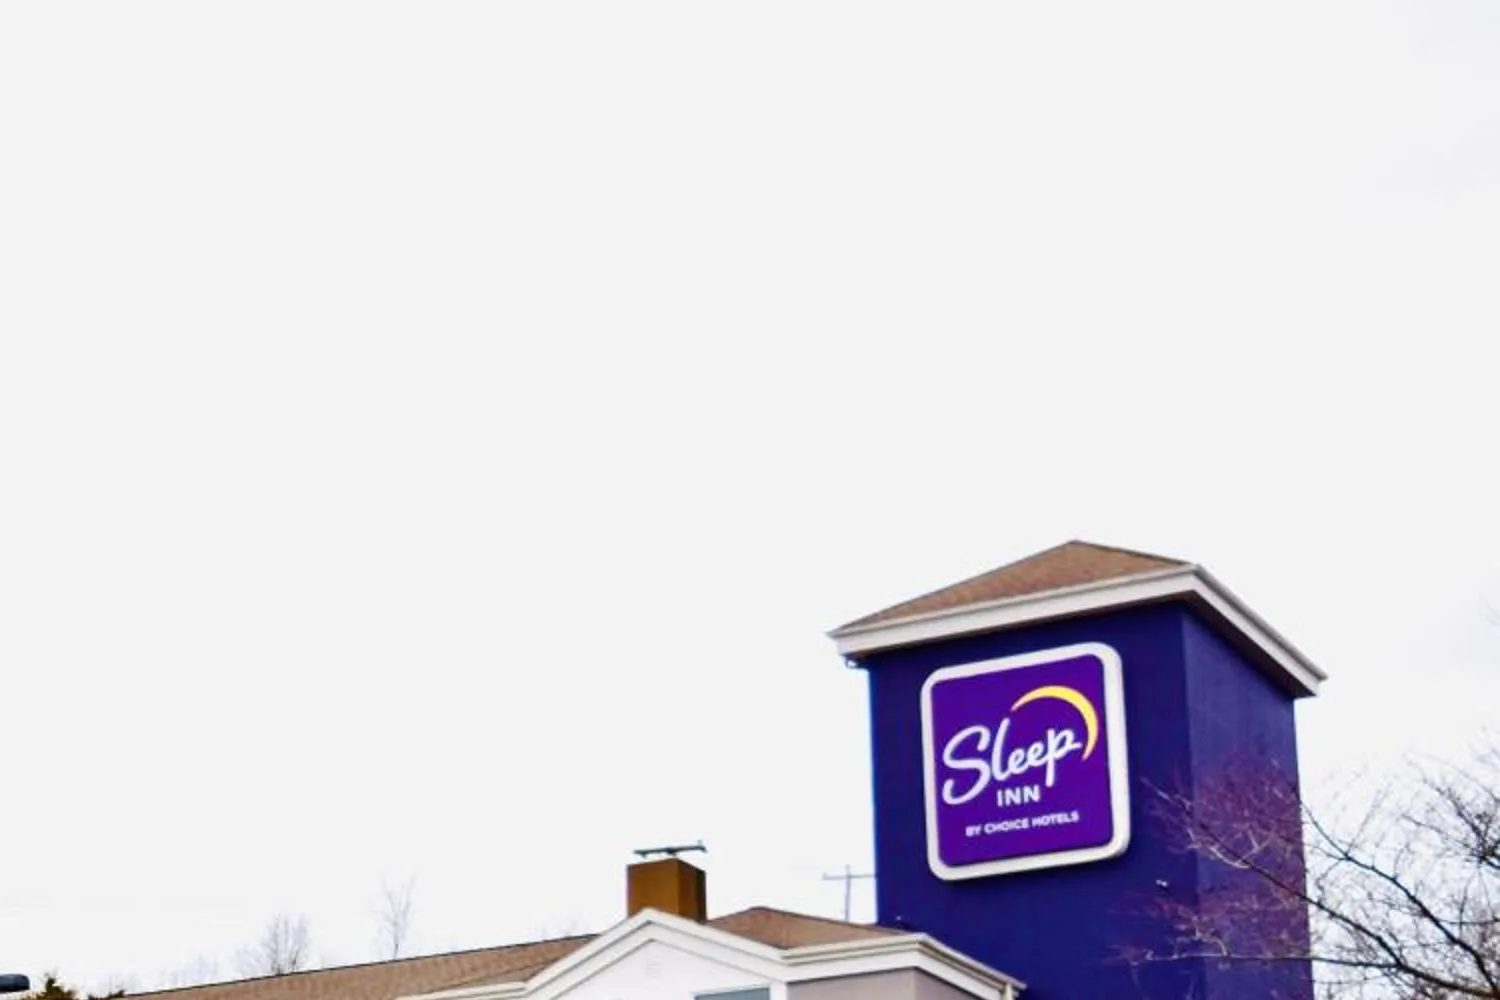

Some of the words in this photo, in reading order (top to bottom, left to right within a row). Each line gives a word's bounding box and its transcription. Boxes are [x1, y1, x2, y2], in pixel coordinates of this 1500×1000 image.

[942, 717, 1082, 805] Sleep
[997, 784, 1041, 807] INN
[965, 825, 981, 837] BY
[984, 817, 1029, 834] CHOICE
[1031, 811, 1079, 827] HOTELS
